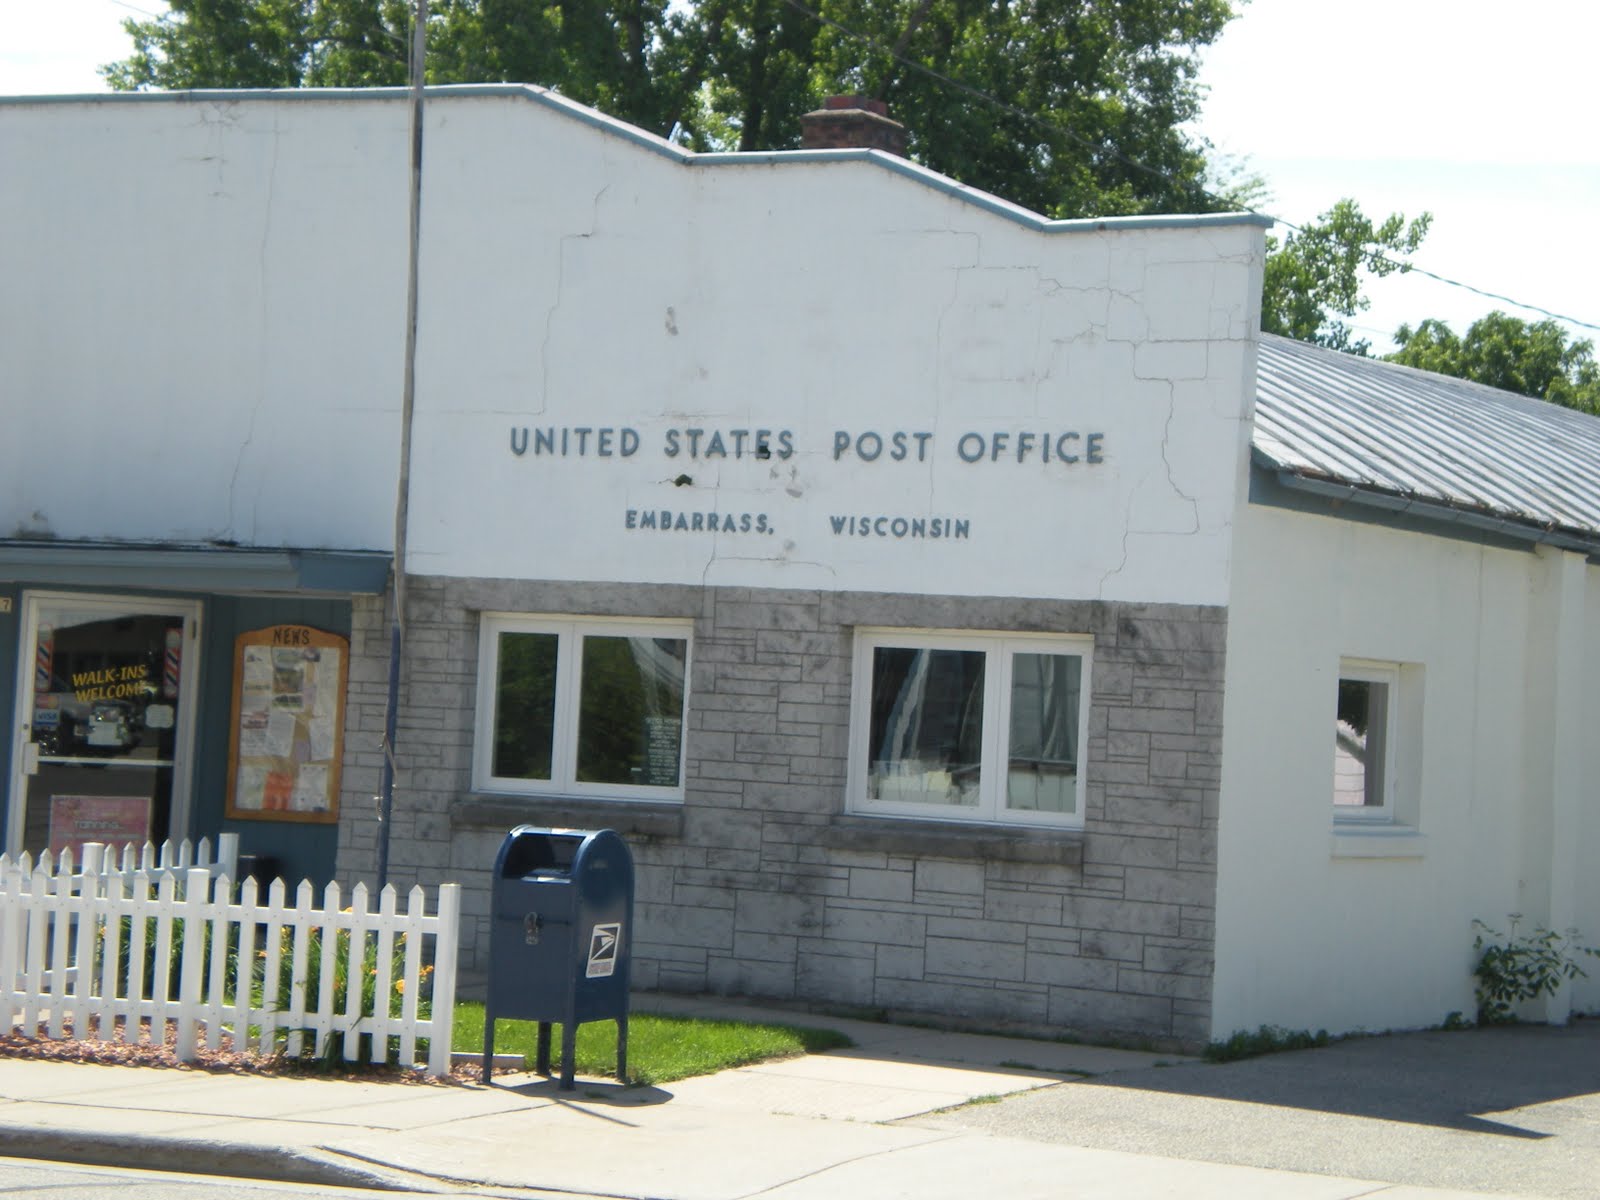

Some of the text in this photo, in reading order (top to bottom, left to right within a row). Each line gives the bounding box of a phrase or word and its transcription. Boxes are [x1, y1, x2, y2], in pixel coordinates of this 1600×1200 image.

[510, 427, 1105, 464] UNITED STATES POST OFFICE
[625, 509, 970, 539] EMBARRASS, WISCONSIN
[273, 628, 310, 645] NEWS
[73, 664, 146, 687] WALK-INS
[76, 681, 146, 703] WELCOME
